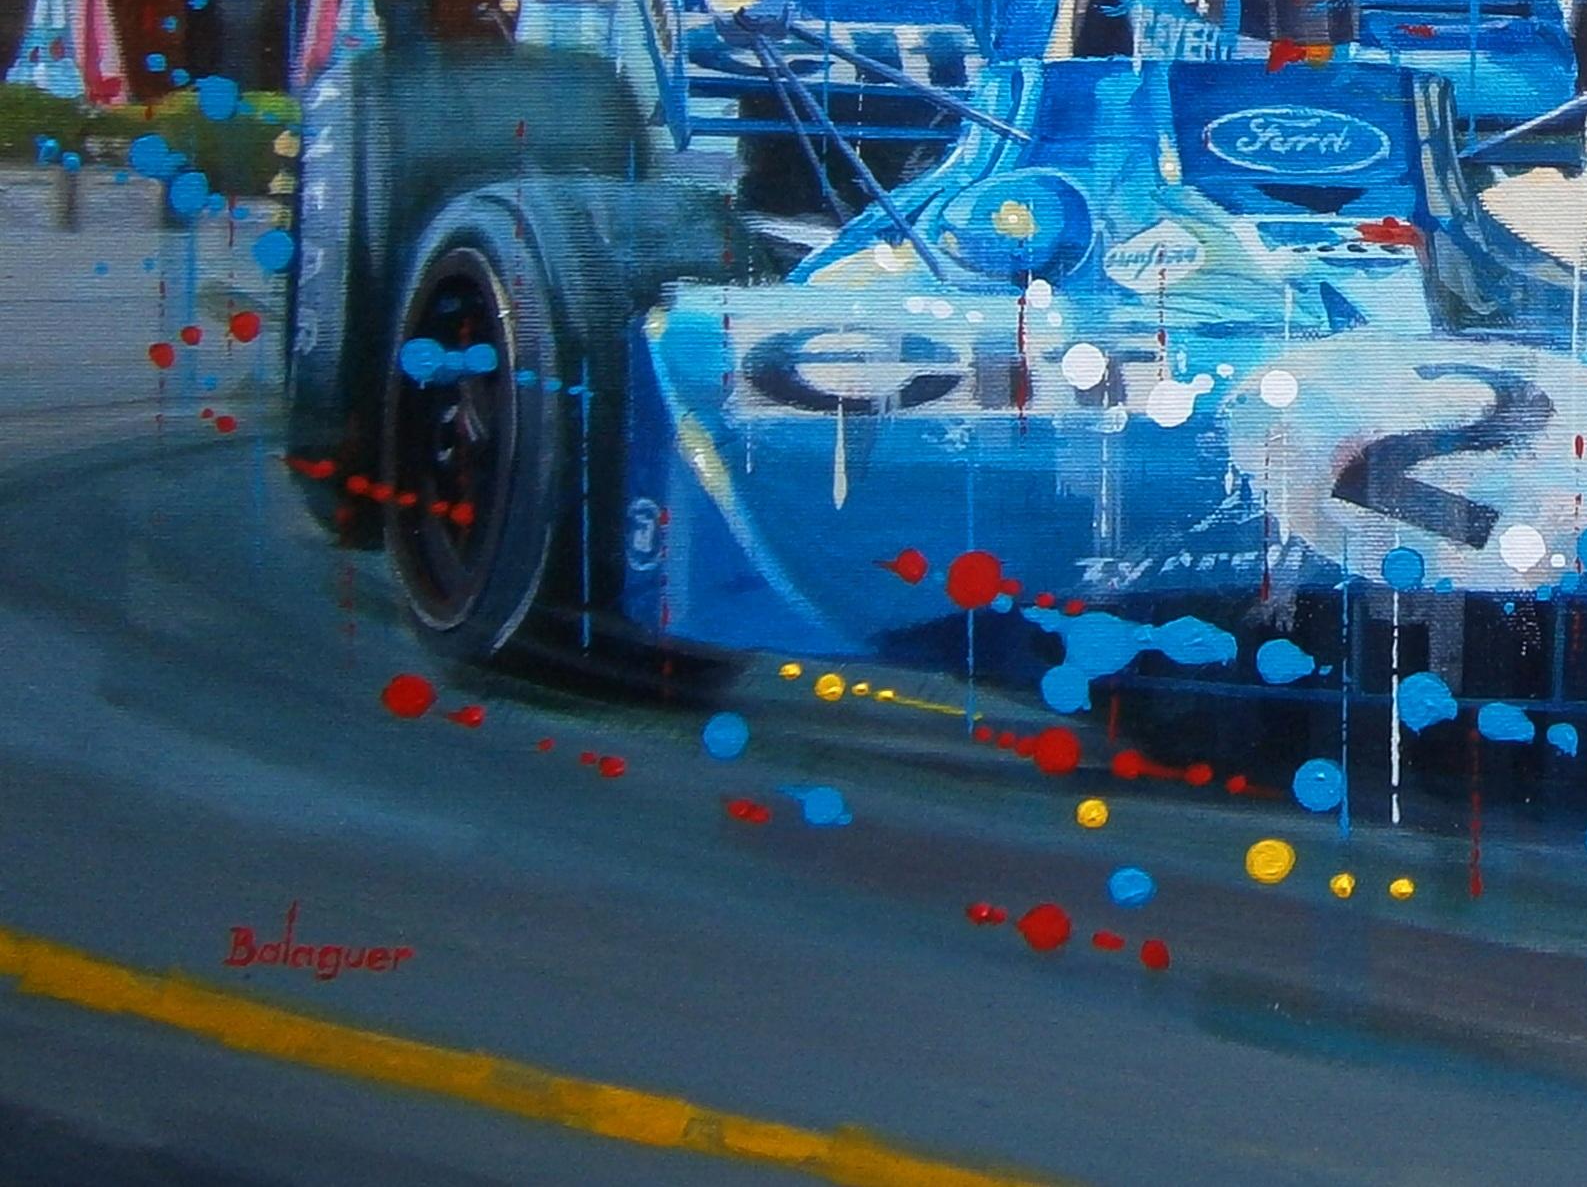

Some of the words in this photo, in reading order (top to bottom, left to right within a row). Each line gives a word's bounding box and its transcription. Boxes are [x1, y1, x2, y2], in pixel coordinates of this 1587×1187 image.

[1235, 116, 1353, 155] Ford
[1331, 362, 1557, 551] 2
[222, 899, 417, 983] Balaguer
